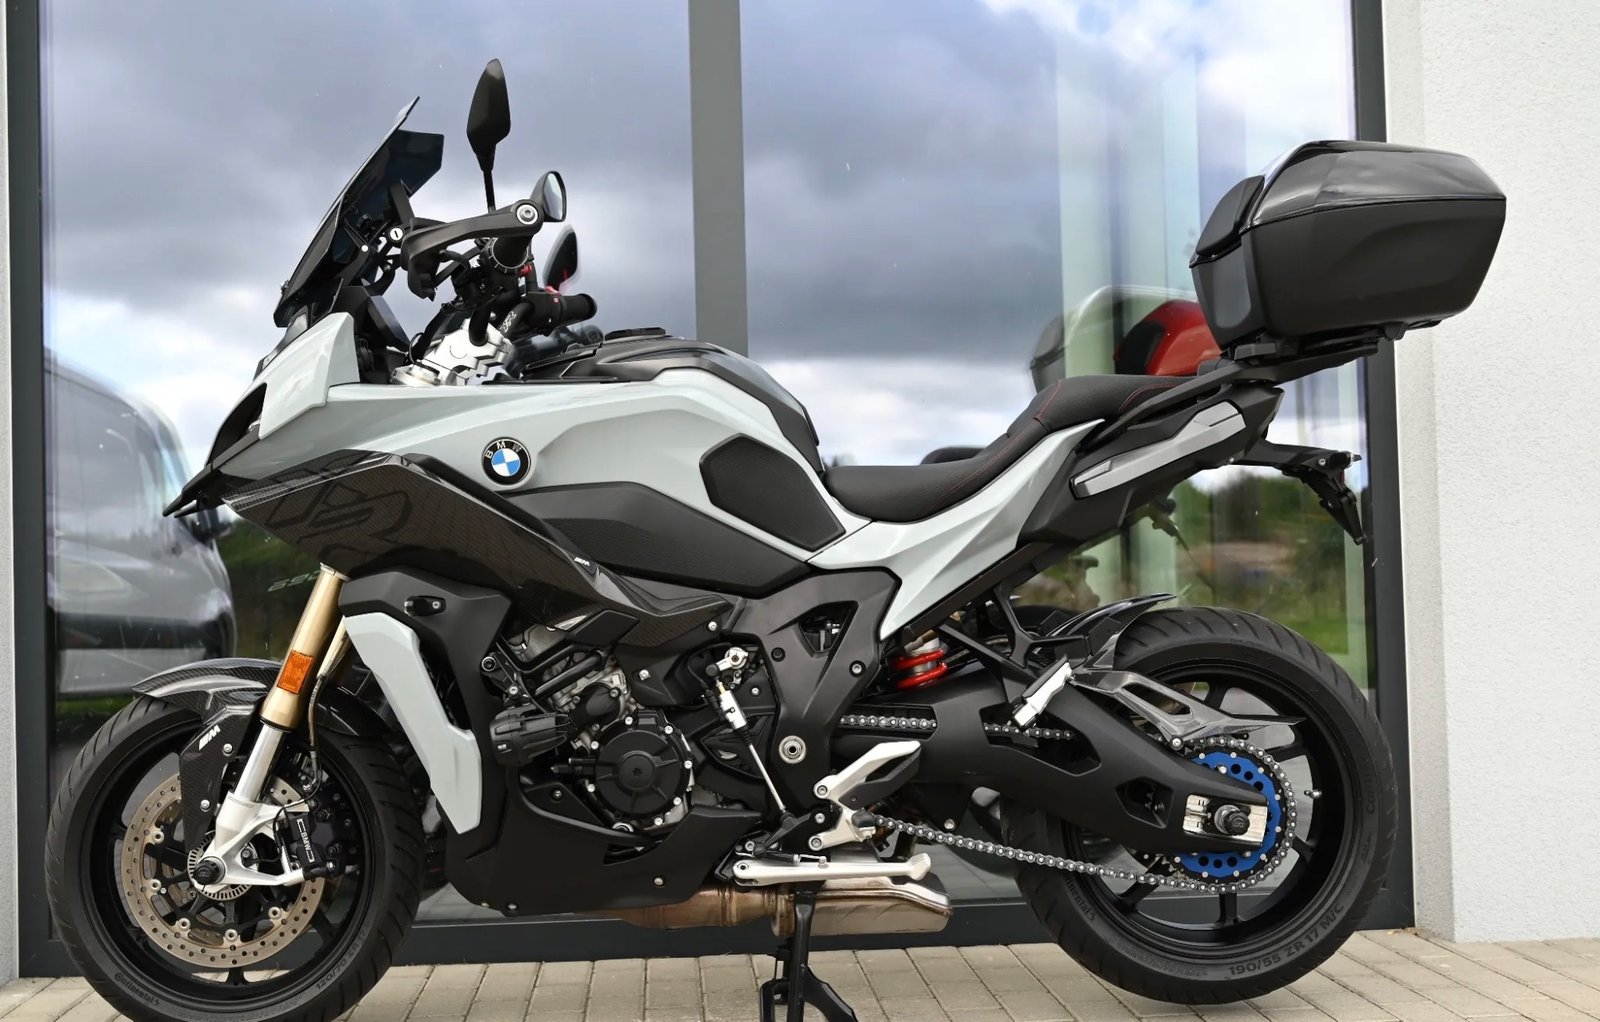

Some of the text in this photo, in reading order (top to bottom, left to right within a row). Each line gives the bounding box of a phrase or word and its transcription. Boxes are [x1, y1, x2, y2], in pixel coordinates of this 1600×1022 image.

[485, 441, 522, 459] BMW
[300, 832, 312, 850] BMW
[1229, 954, 1282, 976] 190/55
[1285, 942, 1306, 957] ZR
[1305, 928, 1319, 943] 17
[1320, 902, 1344, 930] M/C
